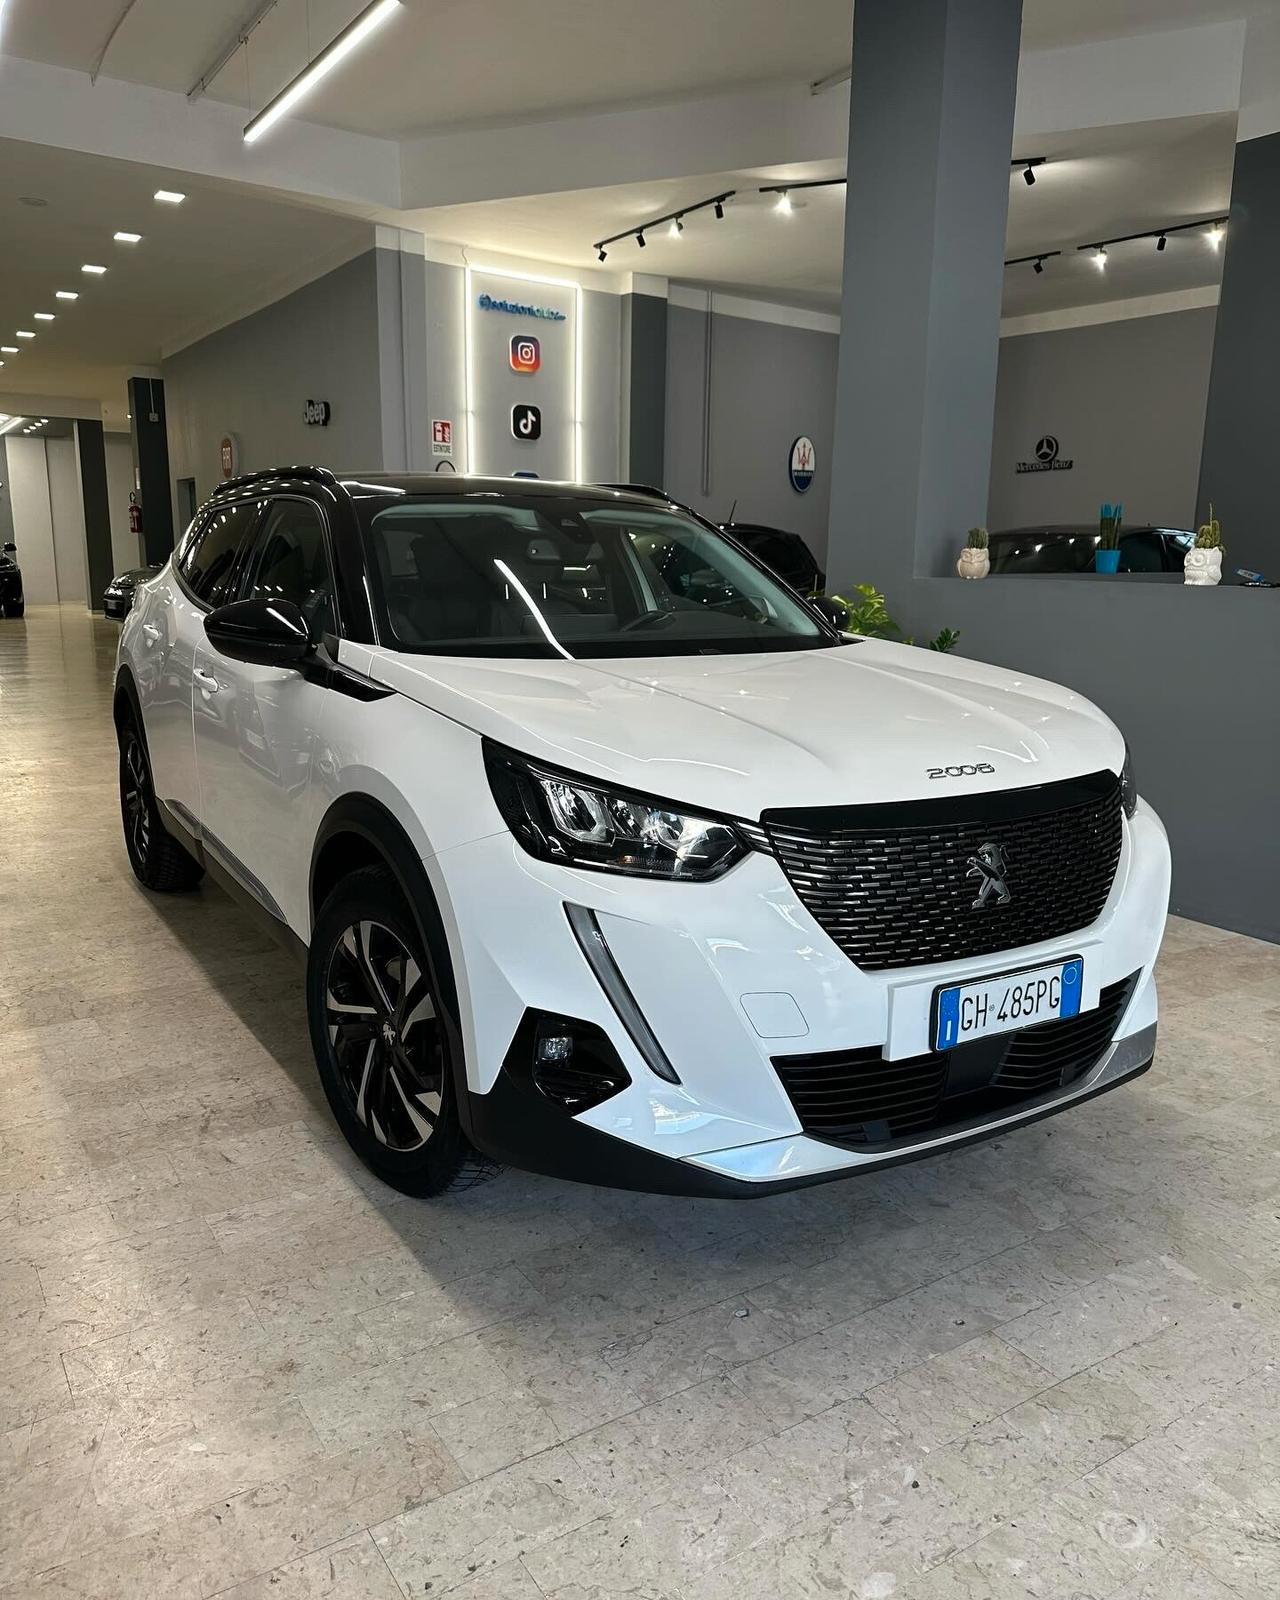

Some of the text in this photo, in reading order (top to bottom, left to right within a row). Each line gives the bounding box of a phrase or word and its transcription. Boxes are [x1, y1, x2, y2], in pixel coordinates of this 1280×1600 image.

[303, 399, 330, 426] Jeep
[926, 763, 995, 779] 2008
[961, 993, 988, 1031] GH
[997, 975, 1061, 1022] 485PG
